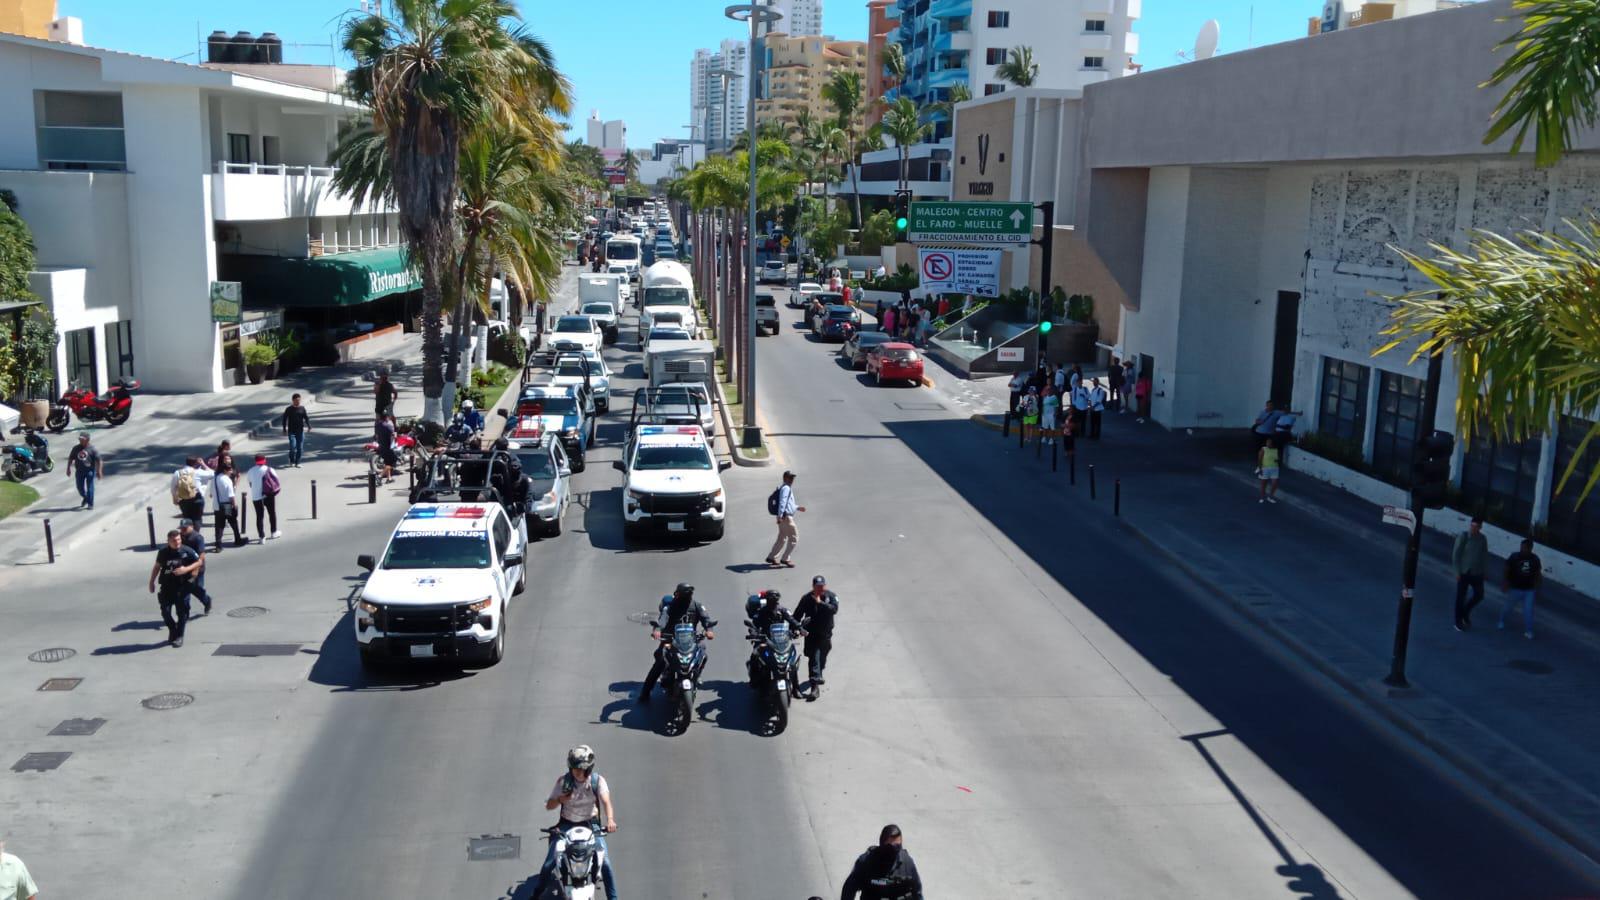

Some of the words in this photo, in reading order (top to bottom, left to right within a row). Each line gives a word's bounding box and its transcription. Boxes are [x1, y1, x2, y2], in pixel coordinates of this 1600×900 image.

[916, 207, 960, 216] MALECON
[966, 208, 1004, 217] CENTRO
[916, 220, 927, 228] EL
[930, 220, 956, 229] FARO
[964, 220, 1004, 230] MUELLE
[918, 233, 994, 241] FRACCIONAMIENTO
